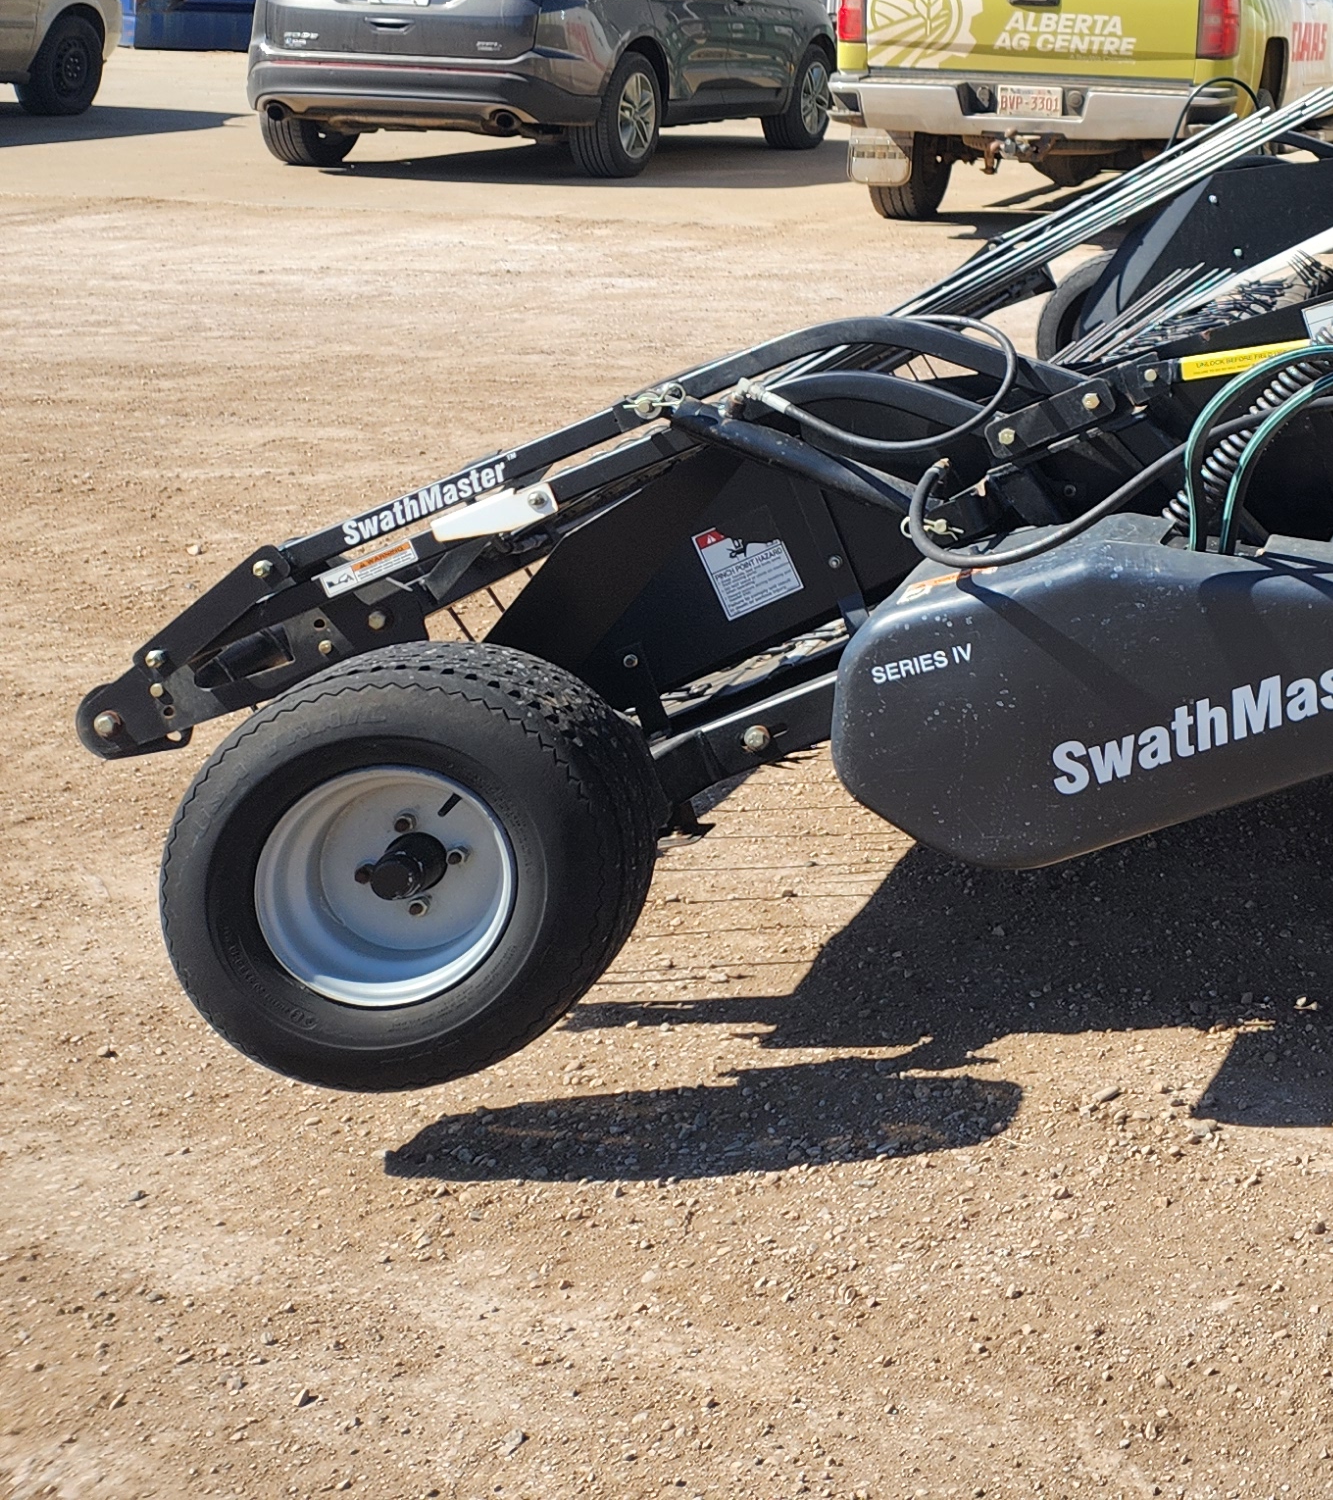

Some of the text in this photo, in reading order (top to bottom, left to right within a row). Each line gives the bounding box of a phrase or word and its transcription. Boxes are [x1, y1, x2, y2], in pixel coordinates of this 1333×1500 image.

[1005, 11, 1123, 36] ALBERTA
[993, 32, 1137, 56] AG CENTRE
[1292, 22, 1327, 62] CLAAS
[1000, 94, 1060, 113] BVP-3301
[341, 459, 506, 546] SwathMaster
[366, 541, 406, 565] WARNING
[715, 547, 783, 581] PINCH POINT HAZARD
[871, 642, 972, 685] SERIES IV
